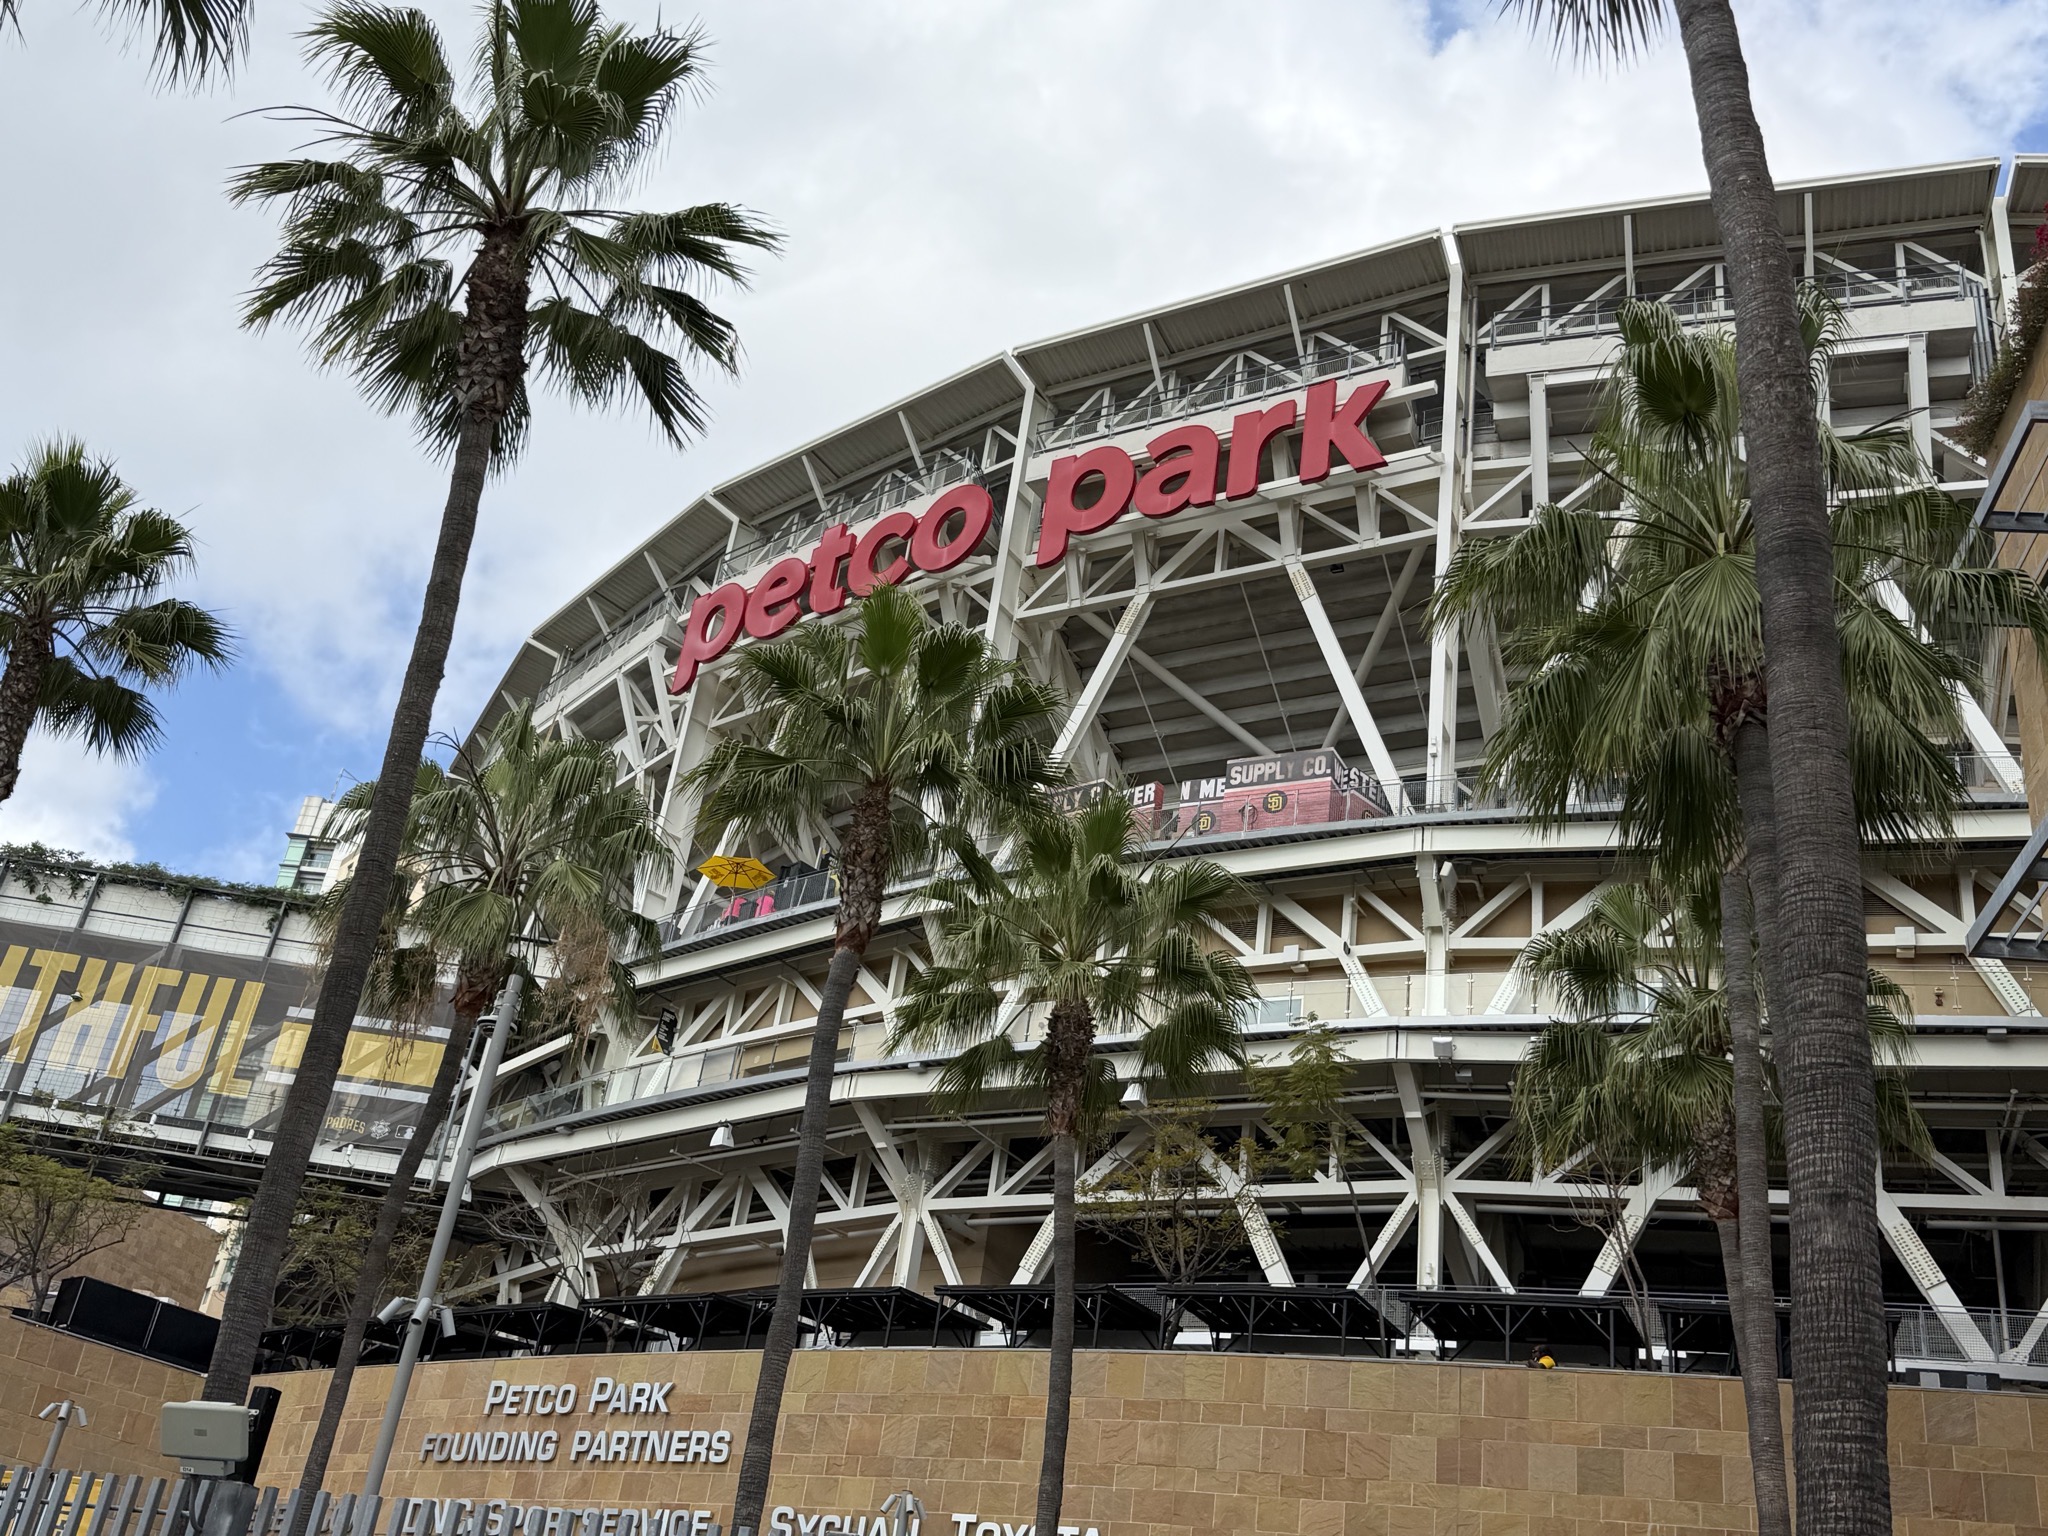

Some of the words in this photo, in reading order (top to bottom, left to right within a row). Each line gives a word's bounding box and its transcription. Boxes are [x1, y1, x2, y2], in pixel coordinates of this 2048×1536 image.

[669, 483, 993, 697] petco
[1036, 378, 1391, 569] park
[1229, 760, 1294, 786] SUPPLY
[1302, 755, 1332, 777] CO.
[325, 1116, 366, 1134] PADRES
[483, 1379, 577, 1416] PETCO
[588, 1376, 675, 1414] PARK
[419, 1430, 559, 1462] FOUNDING
[569, 1430, 732, 1463] PARTNERS
